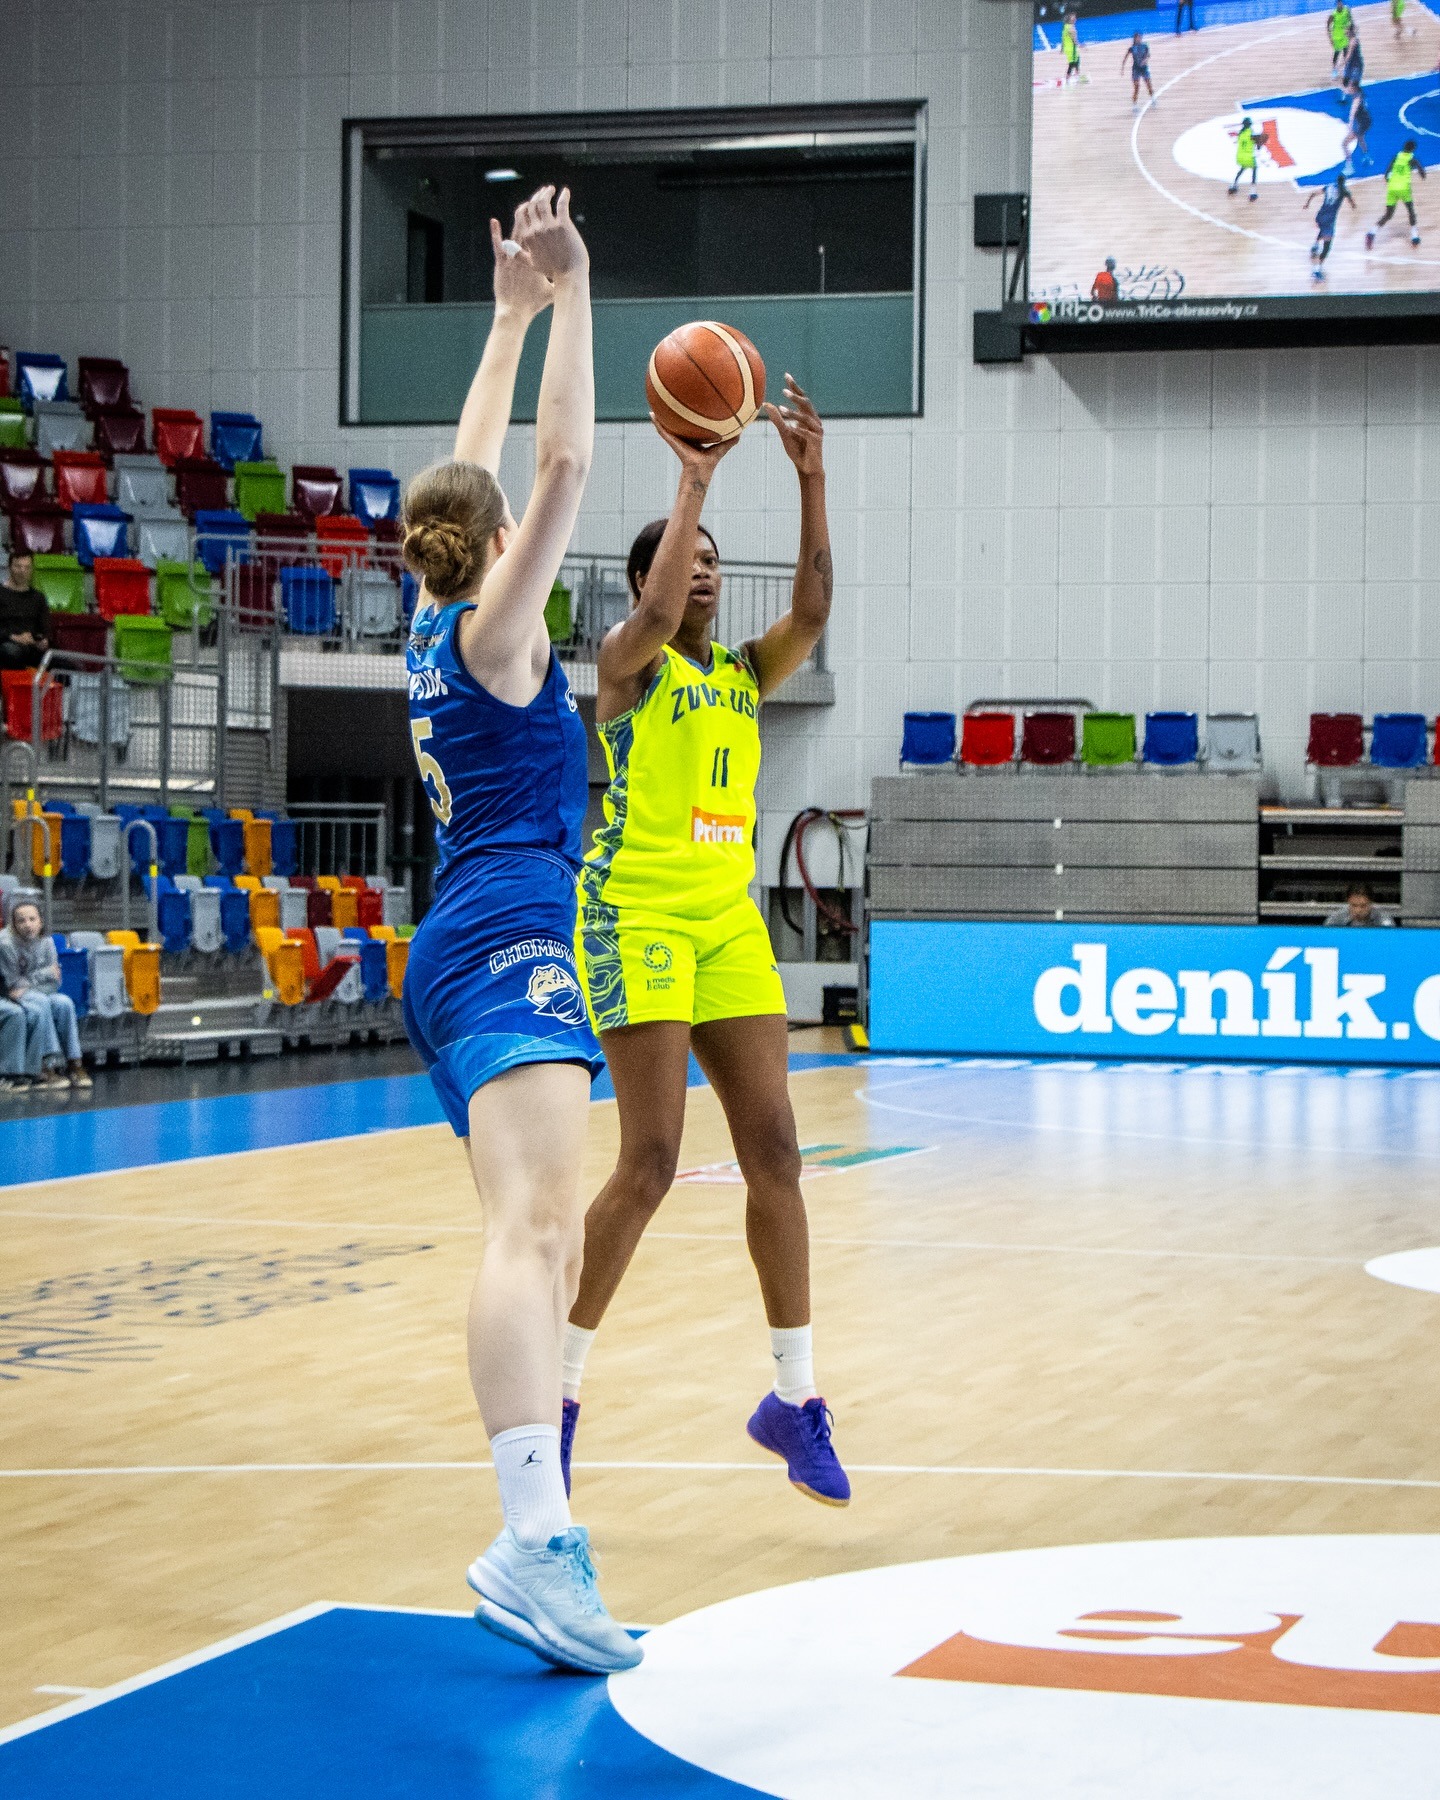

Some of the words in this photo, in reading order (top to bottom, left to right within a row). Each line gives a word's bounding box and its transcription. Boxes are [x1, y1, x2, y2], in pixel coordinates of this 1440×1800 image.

[410, 716, 453, 827] 5
[711, 746, 730, 788] 11
[652, 976, 675, 984] media
